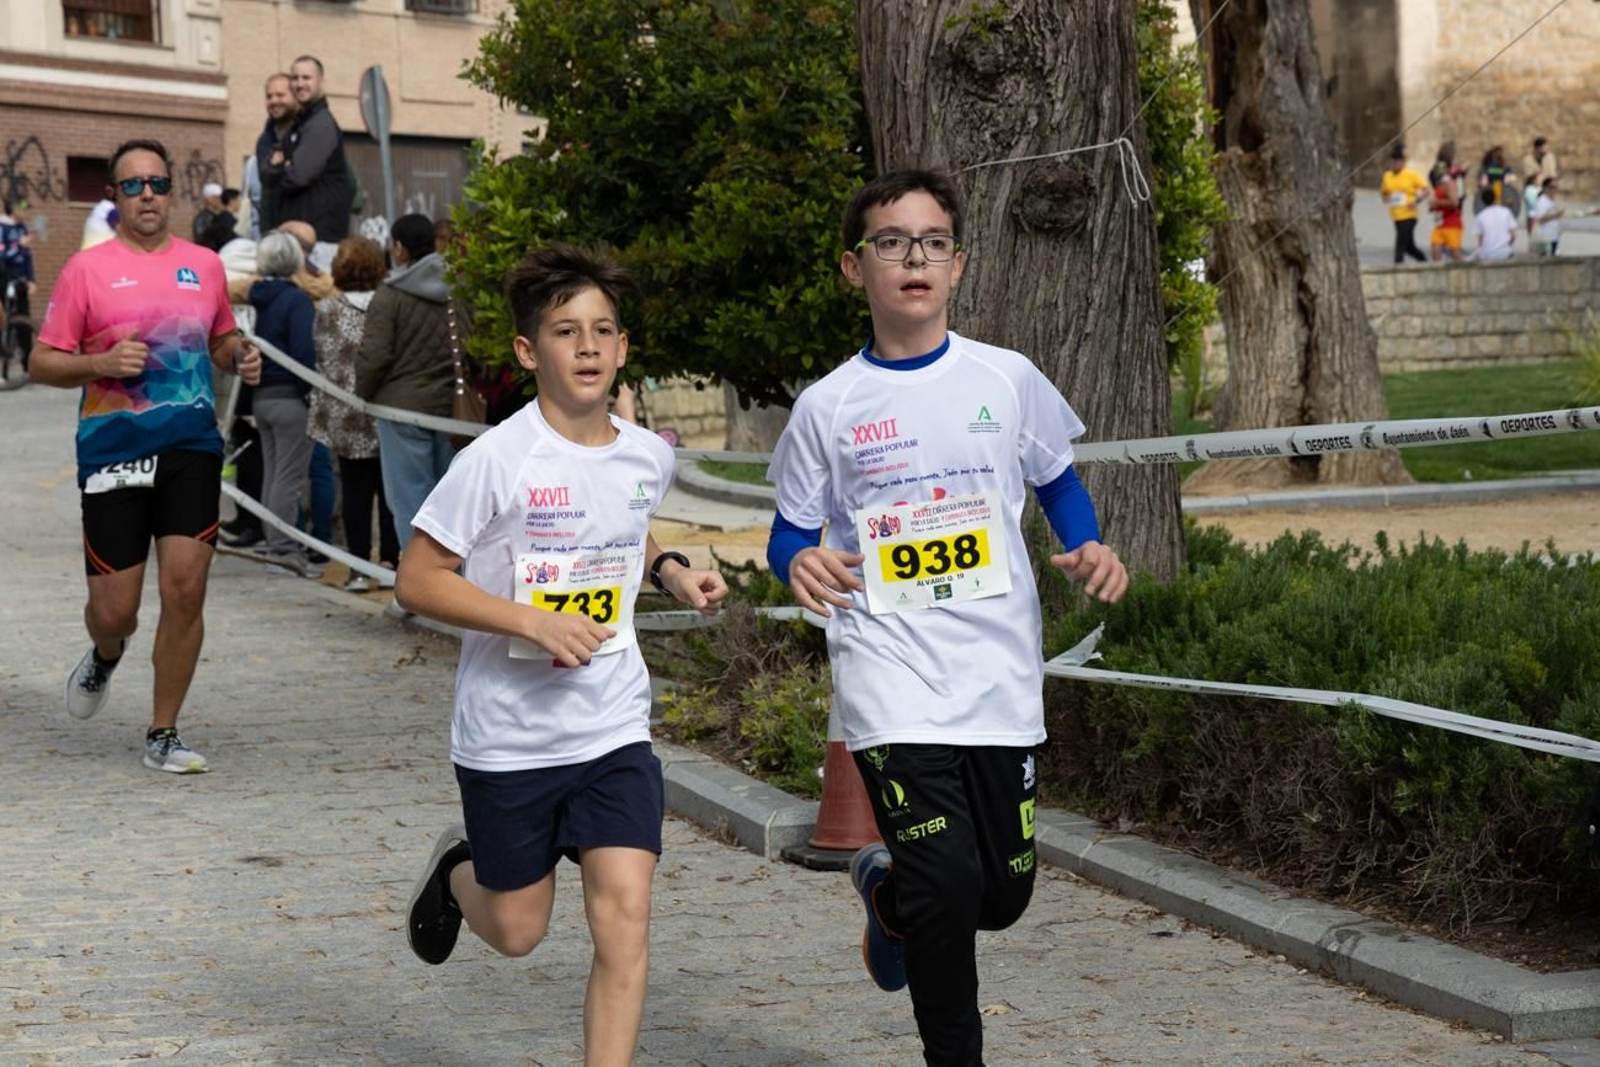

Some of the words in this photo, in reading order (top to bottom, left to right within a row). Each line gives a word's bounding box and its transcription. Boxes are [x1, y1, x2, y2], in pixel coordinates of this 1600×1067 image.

[851, 418, 899, 446] XXVII
[1305, 436, 1353, 452] DEPORTES
[1382, 428, 1437, 446] Ayuntamiento
[1437, 426, 1450, 440] de
[1450, 424, 1471, 439] Jaén
[1500, 415, 1557, 434] DEPORTES
[855, 445, 884, 460] CARRERA
[884, 438, 918, 452] POPULAR
[98, 455, 155, 474] 240
[527, 486, 571, 508] XXVII
[891, 534, 981, 580] 938
[916, 576, 946, 588] ALVARO
[544, 589, 613, 624] 733
